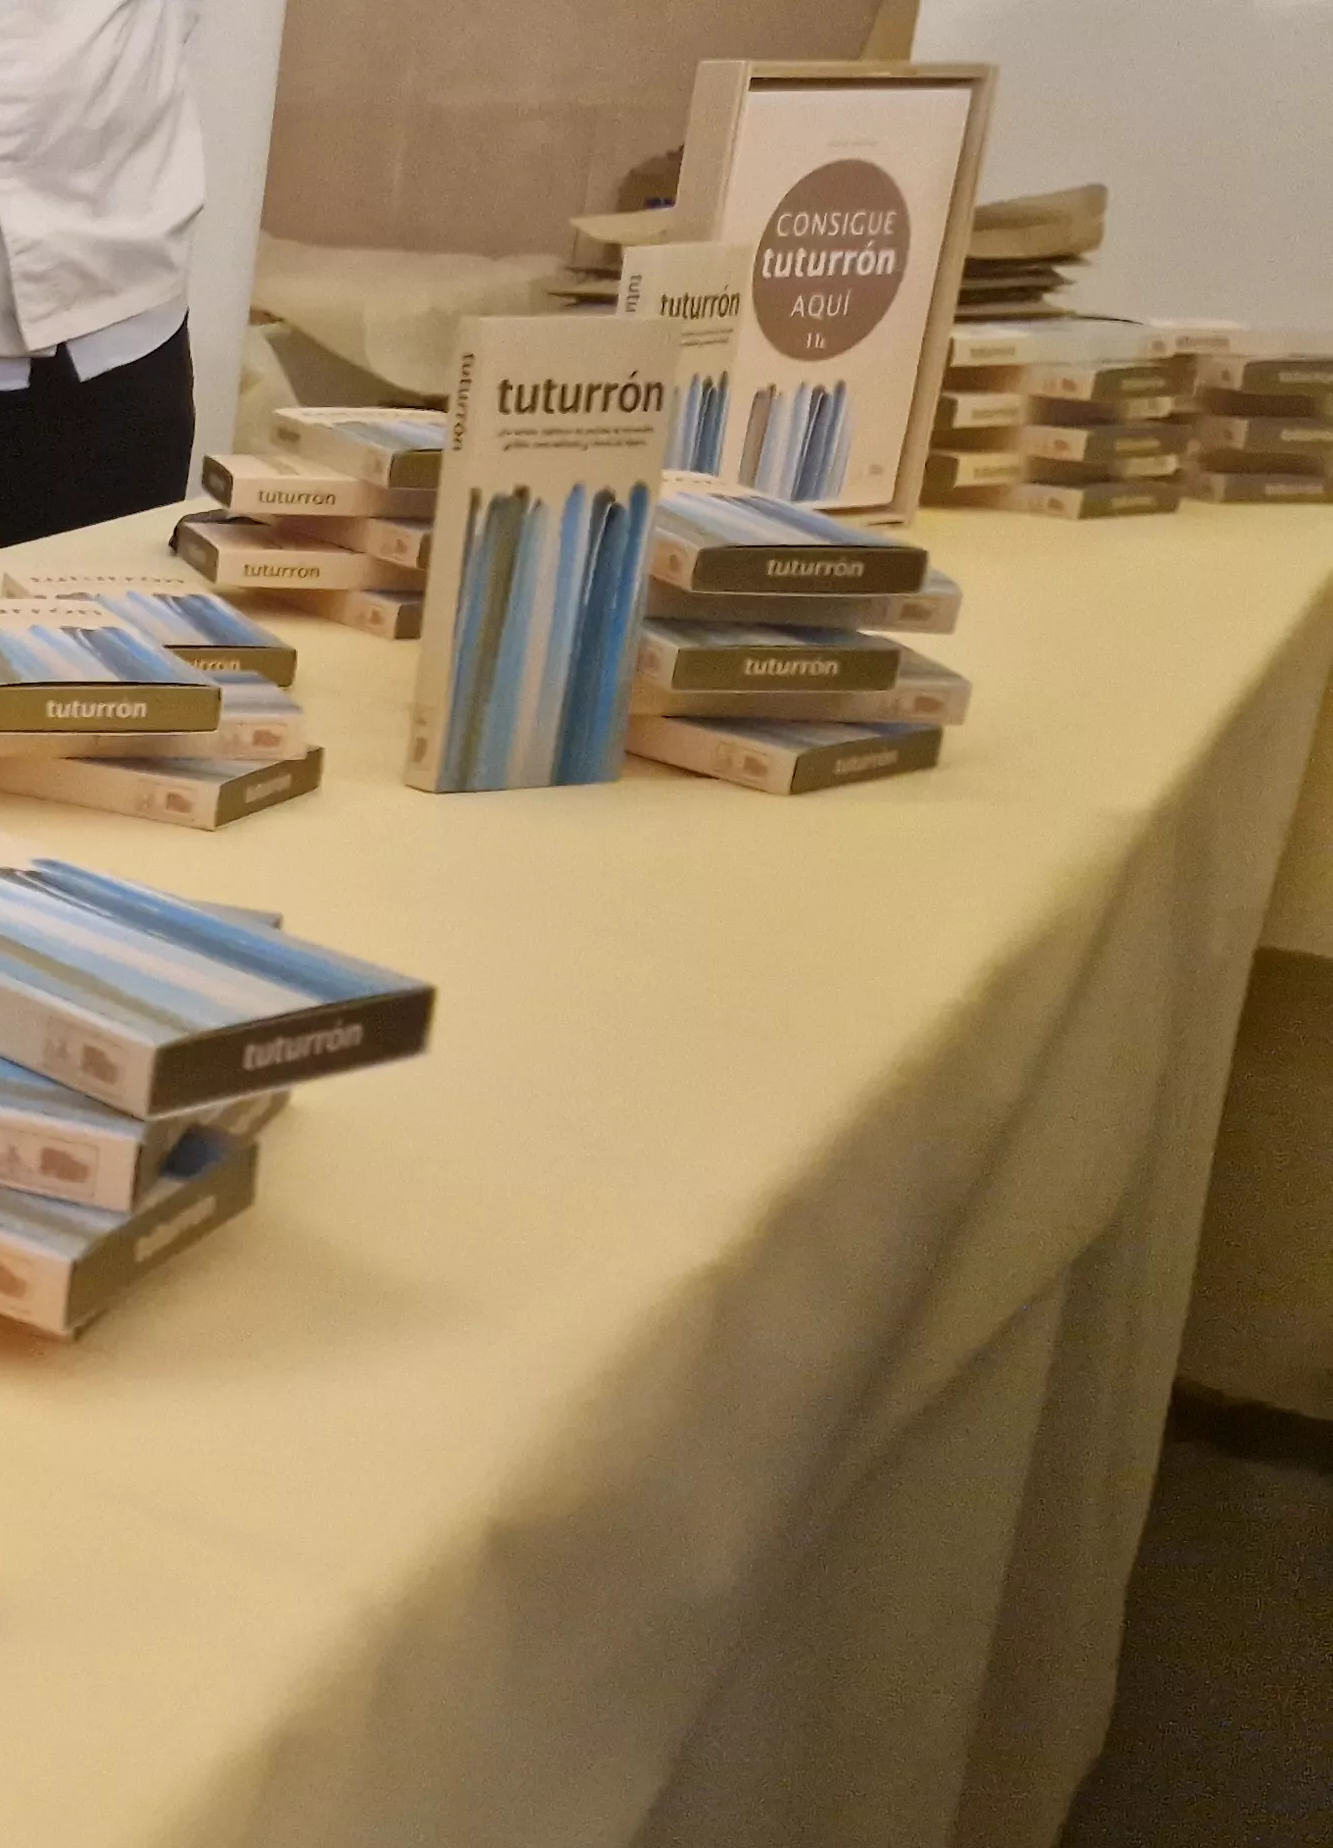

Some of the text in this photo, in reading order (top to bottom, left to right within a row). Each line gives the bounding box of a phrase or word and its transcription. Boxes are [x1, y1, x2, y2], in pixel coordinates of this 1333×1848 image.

[776, 210, 897, 238] CONSIGUE
[762, 240, 896, 279] tuturrón
[660, 284, 740, 320] tuturrón
[790, 288, 852, 319] AQUÍ
[498, 370, 663, 415] tuturrón
[766, 556, 865, 578] tuturrón
[744, 655, 839, 676] tuturrón
[45, 698, 148, 719] tuturrón
[243, 1020, 364, 1071] tuturrón
